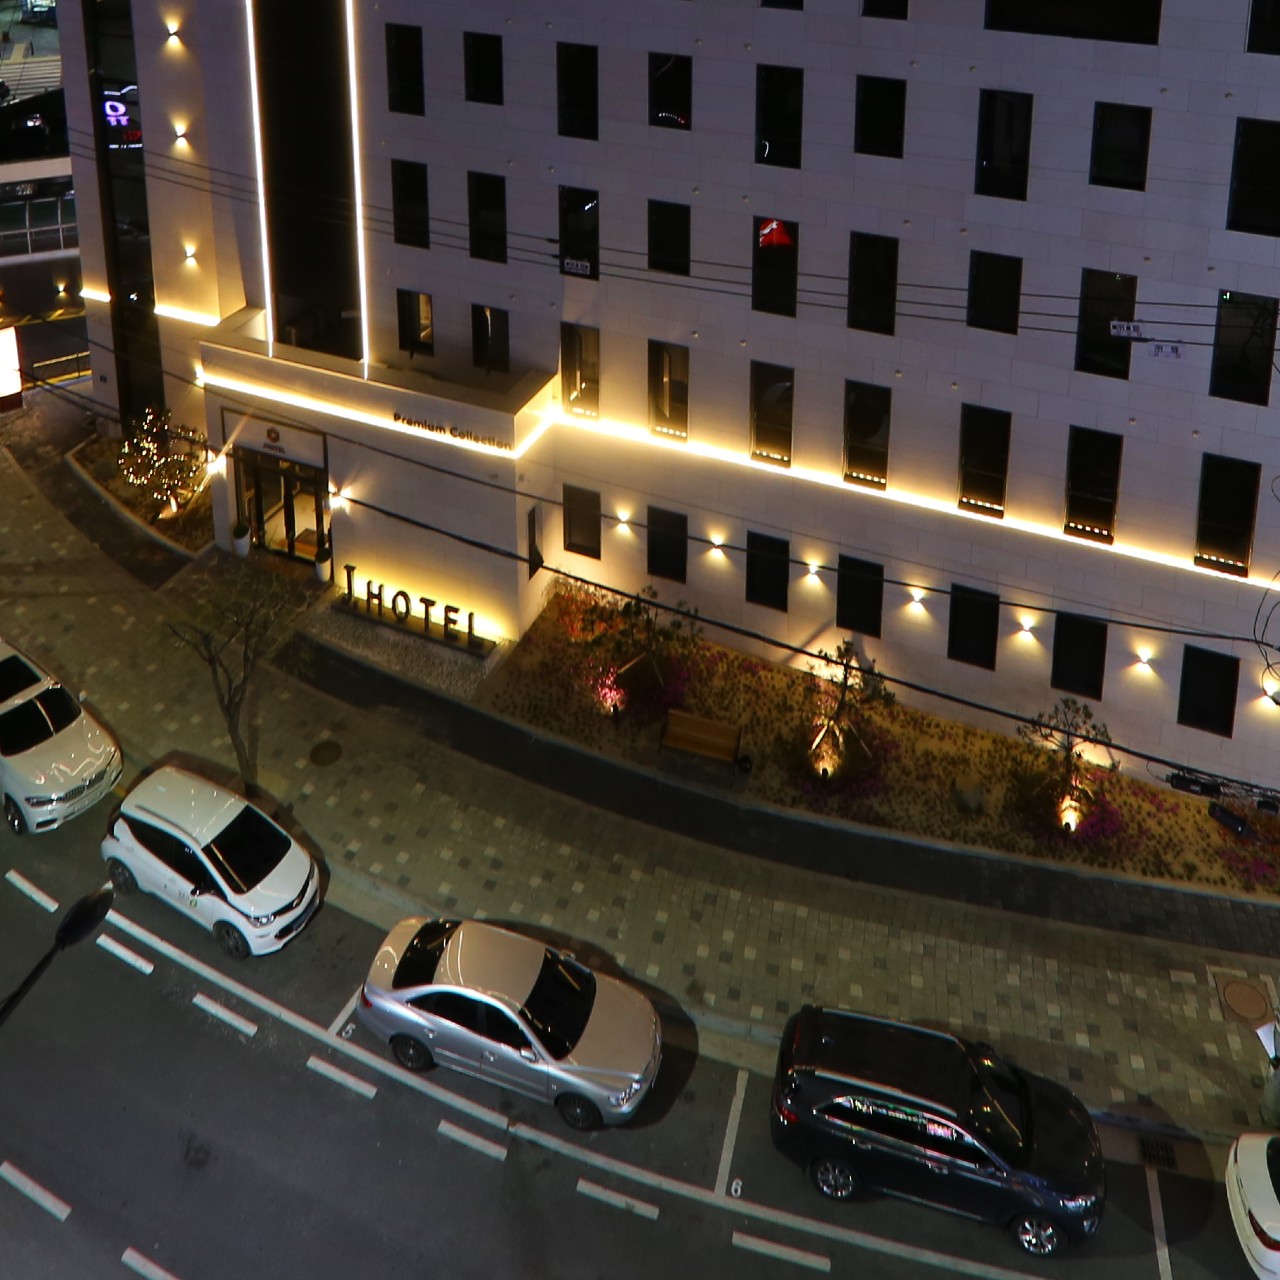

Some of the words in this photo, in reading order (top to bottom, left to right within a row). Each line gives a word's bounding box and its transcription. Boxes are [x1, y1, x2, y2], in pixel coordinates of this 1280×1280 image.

[393, 412, 446, 435] Premium
[449, 427, 512, 451] Collection
[366, 580, 484, 648] HOTEL
[731, 1178, 744, 1200] 6
